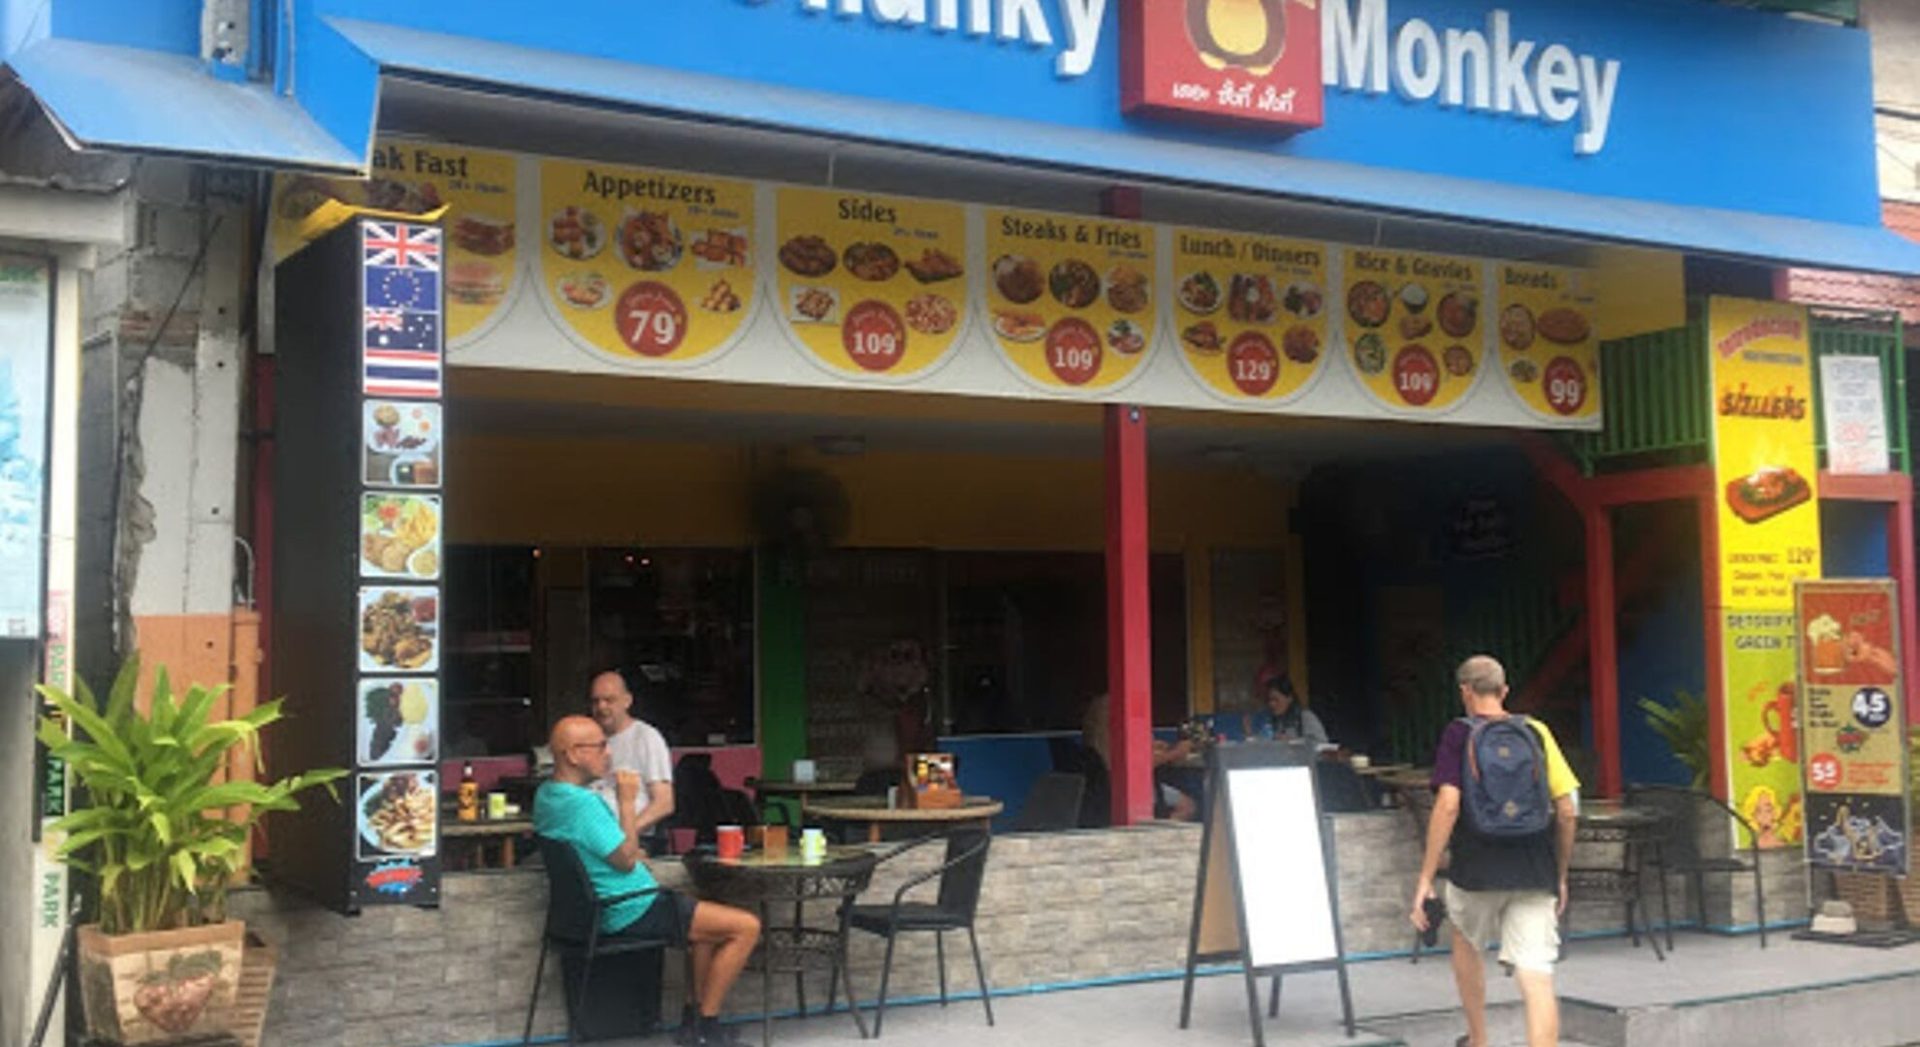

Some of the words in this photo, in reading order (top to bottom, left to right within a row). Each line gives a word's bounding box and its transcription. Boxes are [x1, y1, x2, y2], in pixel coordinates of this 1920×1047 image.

[1322, 0, 1620, 154] Monkey
[414, 150, 468, 177] Fast
[584, 172, 716, 204] Appetizers
[838, 199, 898, 224] Sides
[1002, 215, 1068, 242] Steaks
[1075, 224, 1088, 244] &
[1096, 226, 1142, 248] Fries
[1180, 235, 1236, 258] Lunch
[1251, 243, 1321, 267] Dinners
[1354, 251, 1390, 272] Rice
[629, 310, 675, 345] 79
[852, 331, 896, 355] 109
[1054, 347, 1093, 370] 109
[1235, 361, 1271, 381] 129
[1550, 380, 1580, 406] 99
[1852, 692, 1887, 718] 45
[42, 872, 60, 928] PARK
